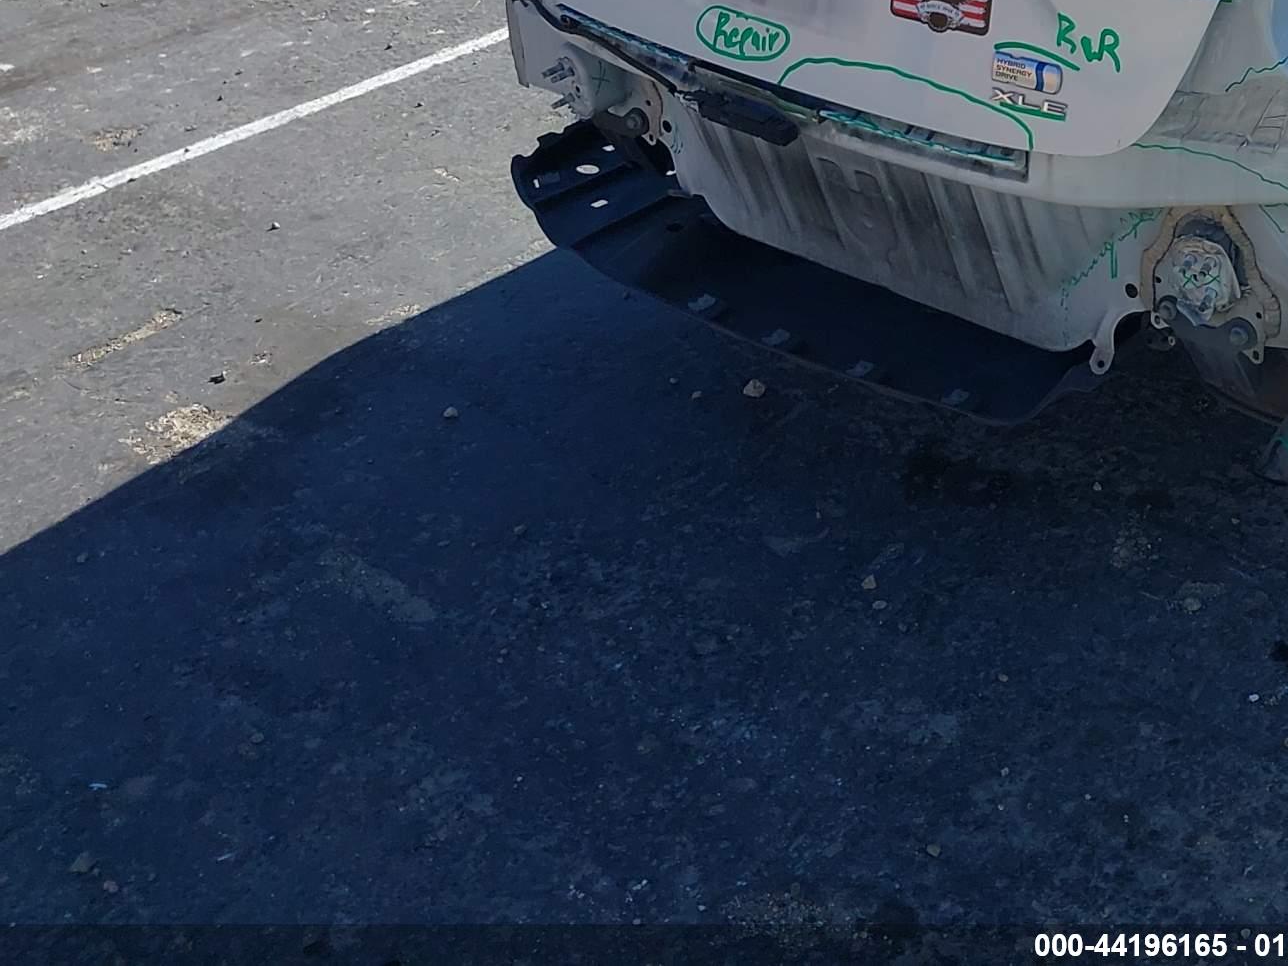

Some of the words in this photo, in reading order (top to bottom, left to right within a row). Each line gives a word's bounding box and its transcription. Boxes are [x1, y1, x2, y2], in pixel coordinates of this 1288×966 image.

[713, 11, 781, 57] Repair
[996, 58, 1026, 70] HYBRID
[996, 64, 1033, 78] SYNERGY
[995, 71, 1019, 82] DRIVE
[992, 86, 1069, 114] XLE
